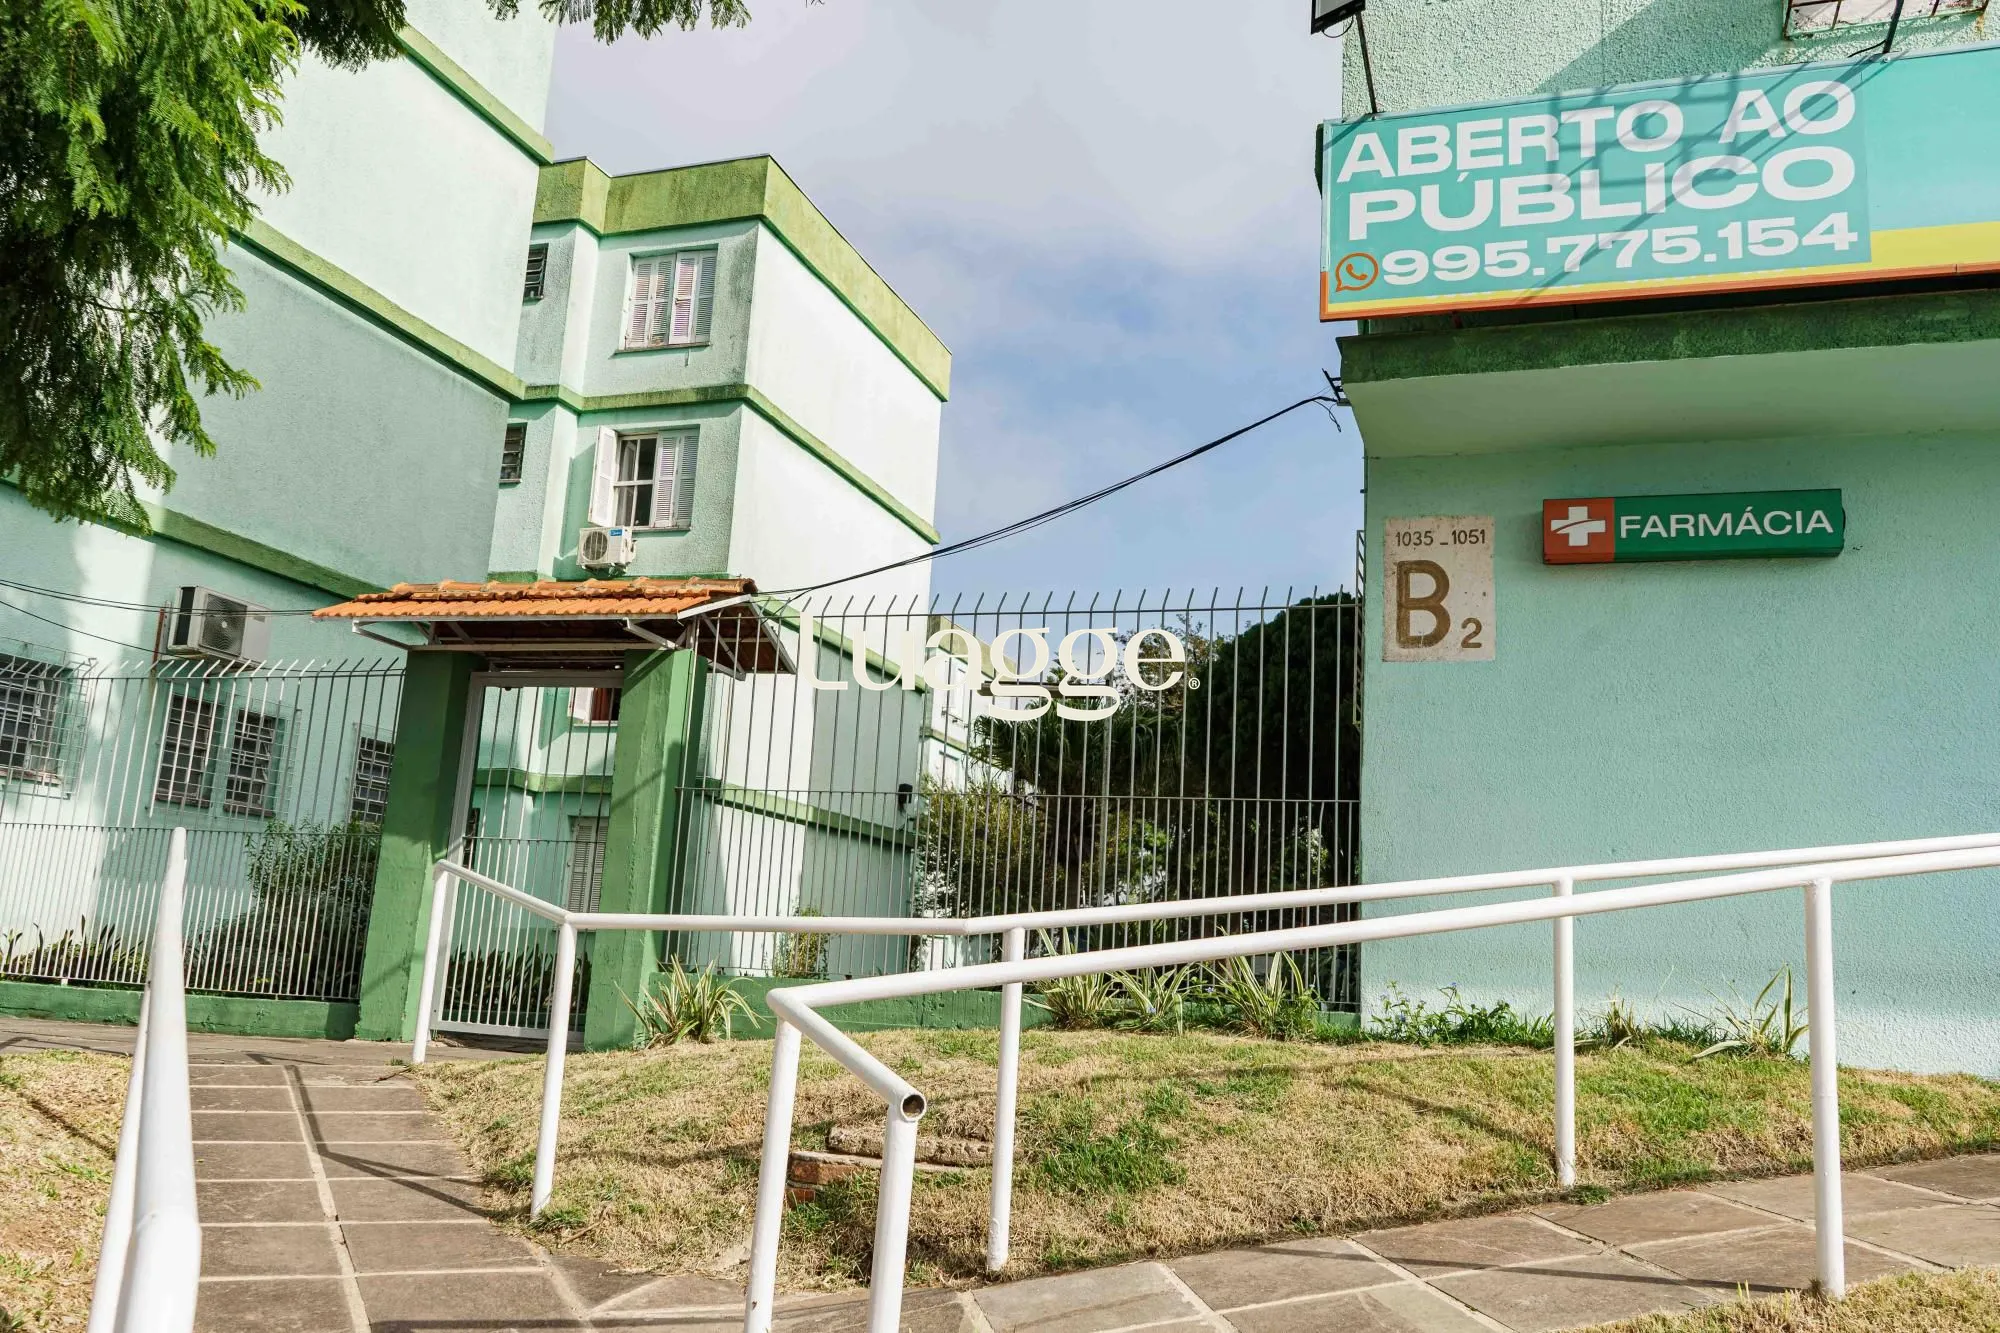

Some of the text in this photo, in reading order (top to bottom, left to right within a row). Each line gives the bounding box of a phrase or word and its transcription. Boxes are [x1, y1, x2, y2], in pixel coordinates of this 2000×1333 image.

[1338, 80, 1855, 183] ABERTO AO
[1348, 146, 1855, 241] PÚBLICO
[1382, 213, 1855, 285] 995.775.154
[1396, 531, 1434, 547] 1035
[1451, 529, 1486, 545] 1051
[1620, 506, 1834, 538] FARMÁCIA
[1396, 560, 1482, 649] B 2
